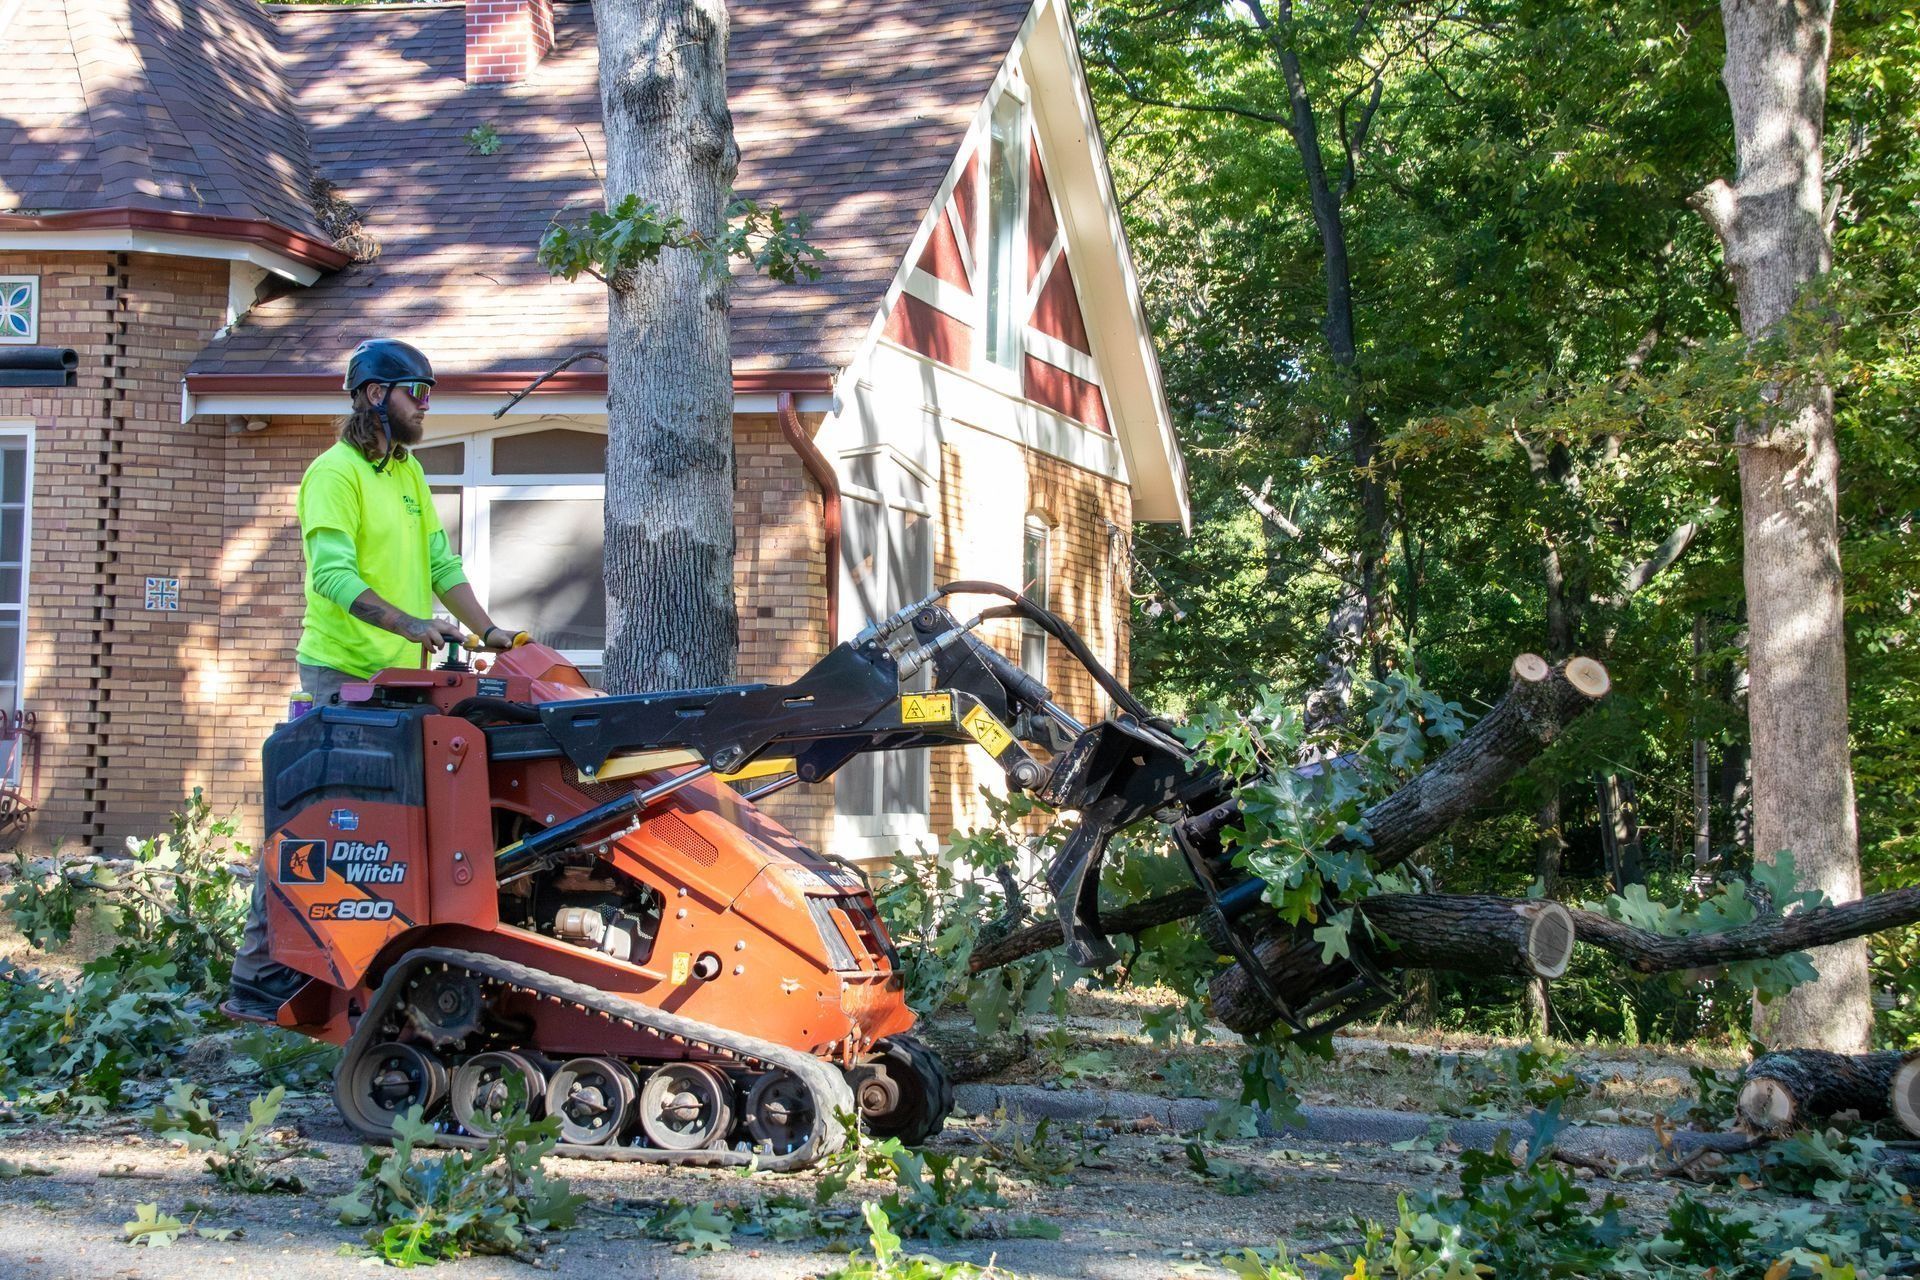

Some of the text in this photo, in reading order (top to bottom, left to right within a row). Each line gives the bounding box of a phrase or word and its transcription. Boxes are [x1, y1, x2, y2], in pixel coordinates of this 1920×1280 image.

[332, 841, 389, 861] Ditch
[346, 863, 405, 882] Witch
[310, 901, 393, 919] SK800
